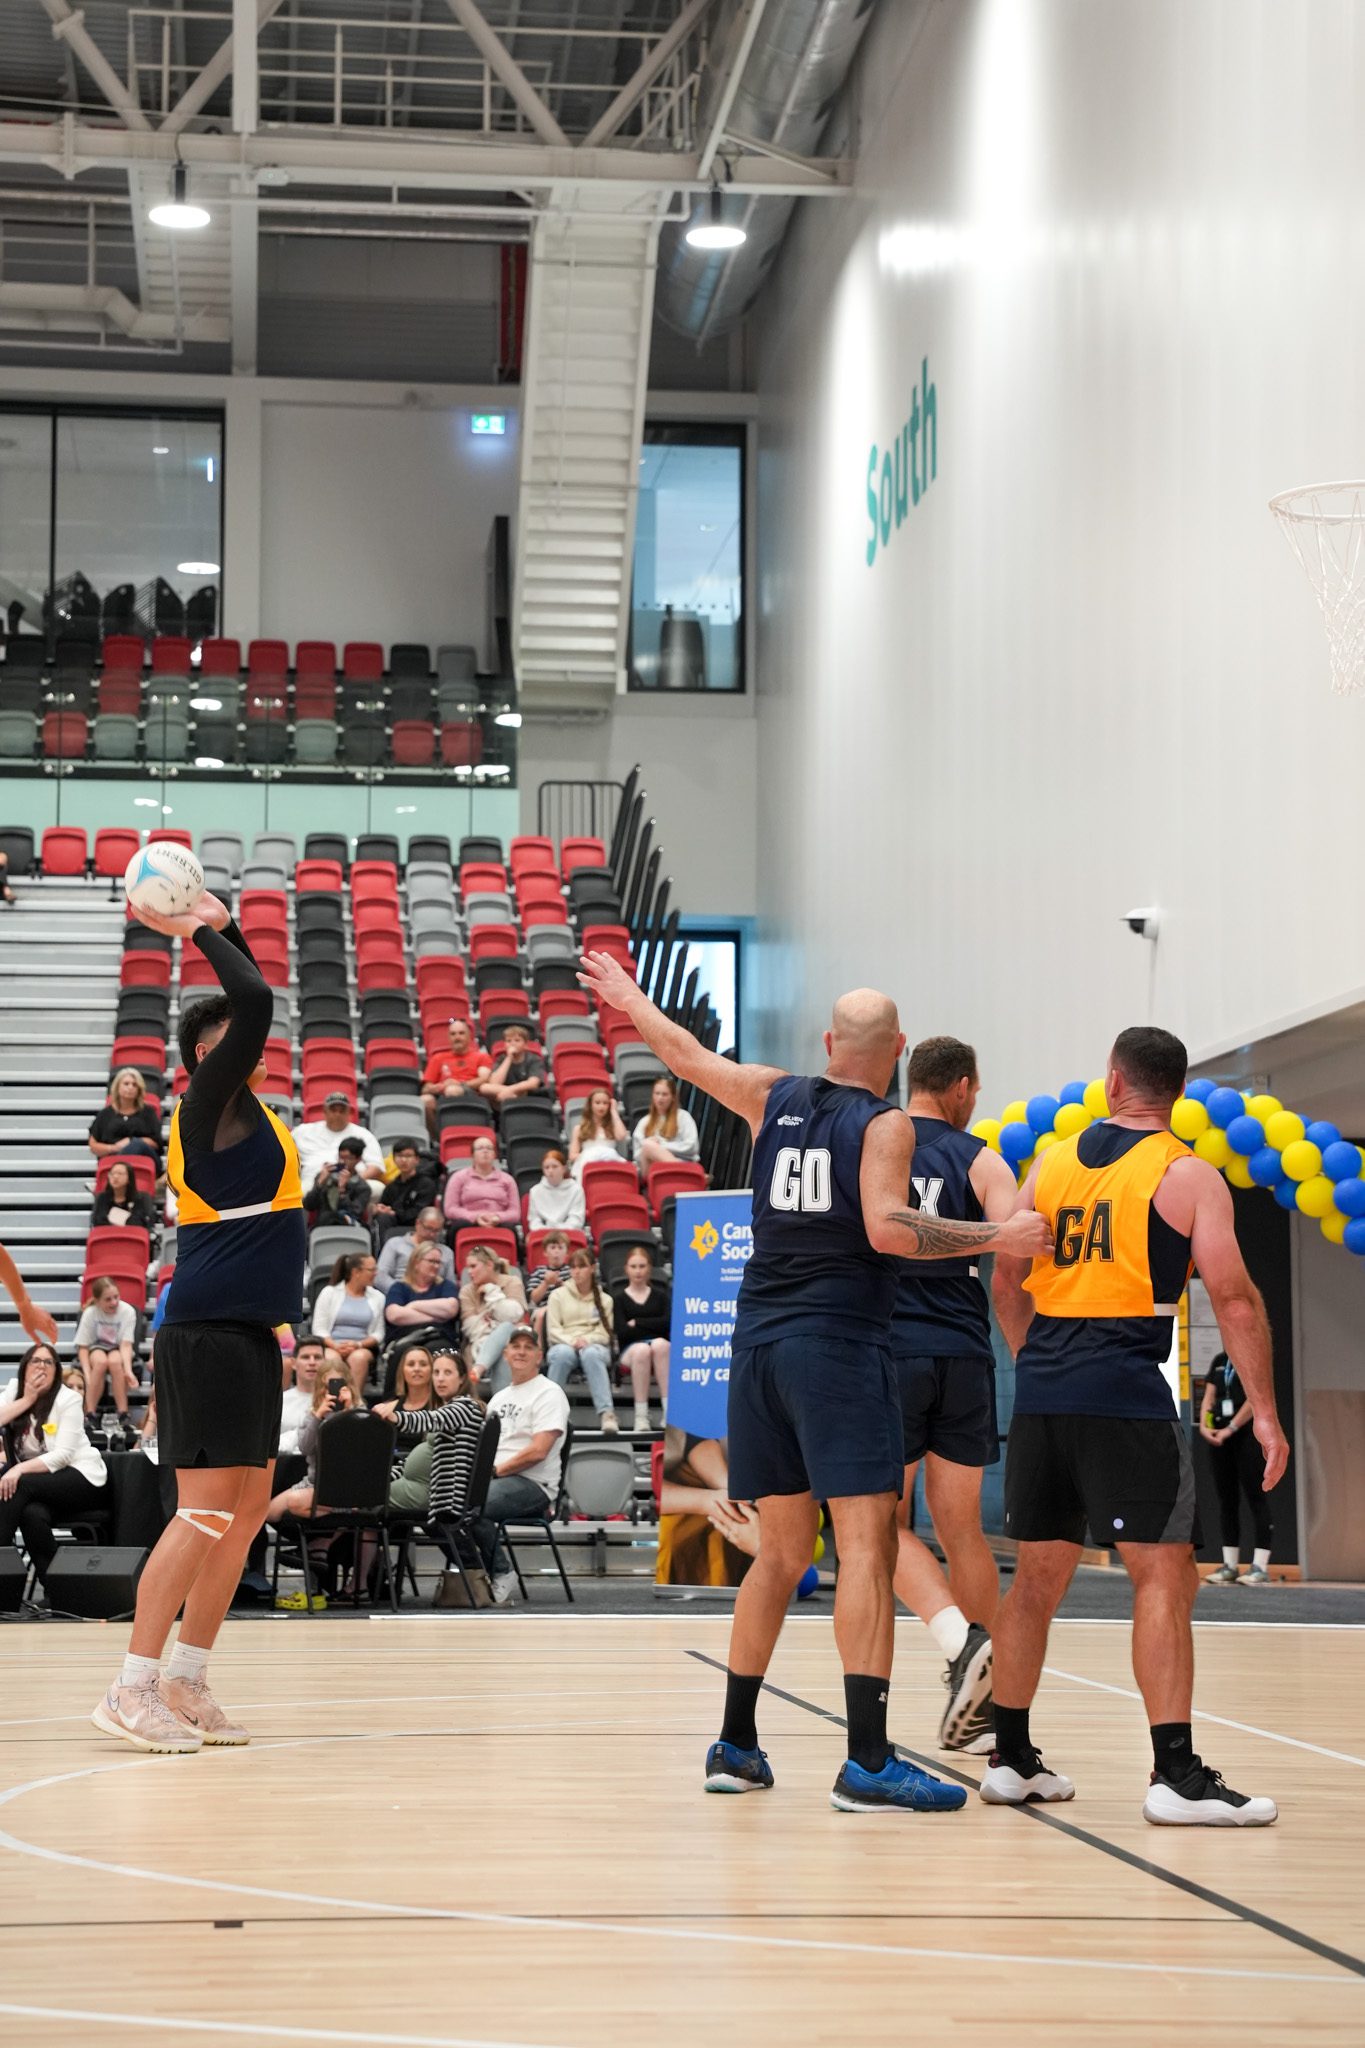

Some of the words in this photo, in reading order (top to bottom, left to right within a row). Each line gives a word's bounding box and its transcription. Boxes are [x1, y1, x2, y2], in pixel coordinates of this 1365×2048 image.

[866, 354, 936, 567] South
[769, 1147, 832, 1212] GD
[1053, 1199, 1114, 1269] GA
[685, 1297, 709, 1314] We
[681, 1368, 710, 1386] any
